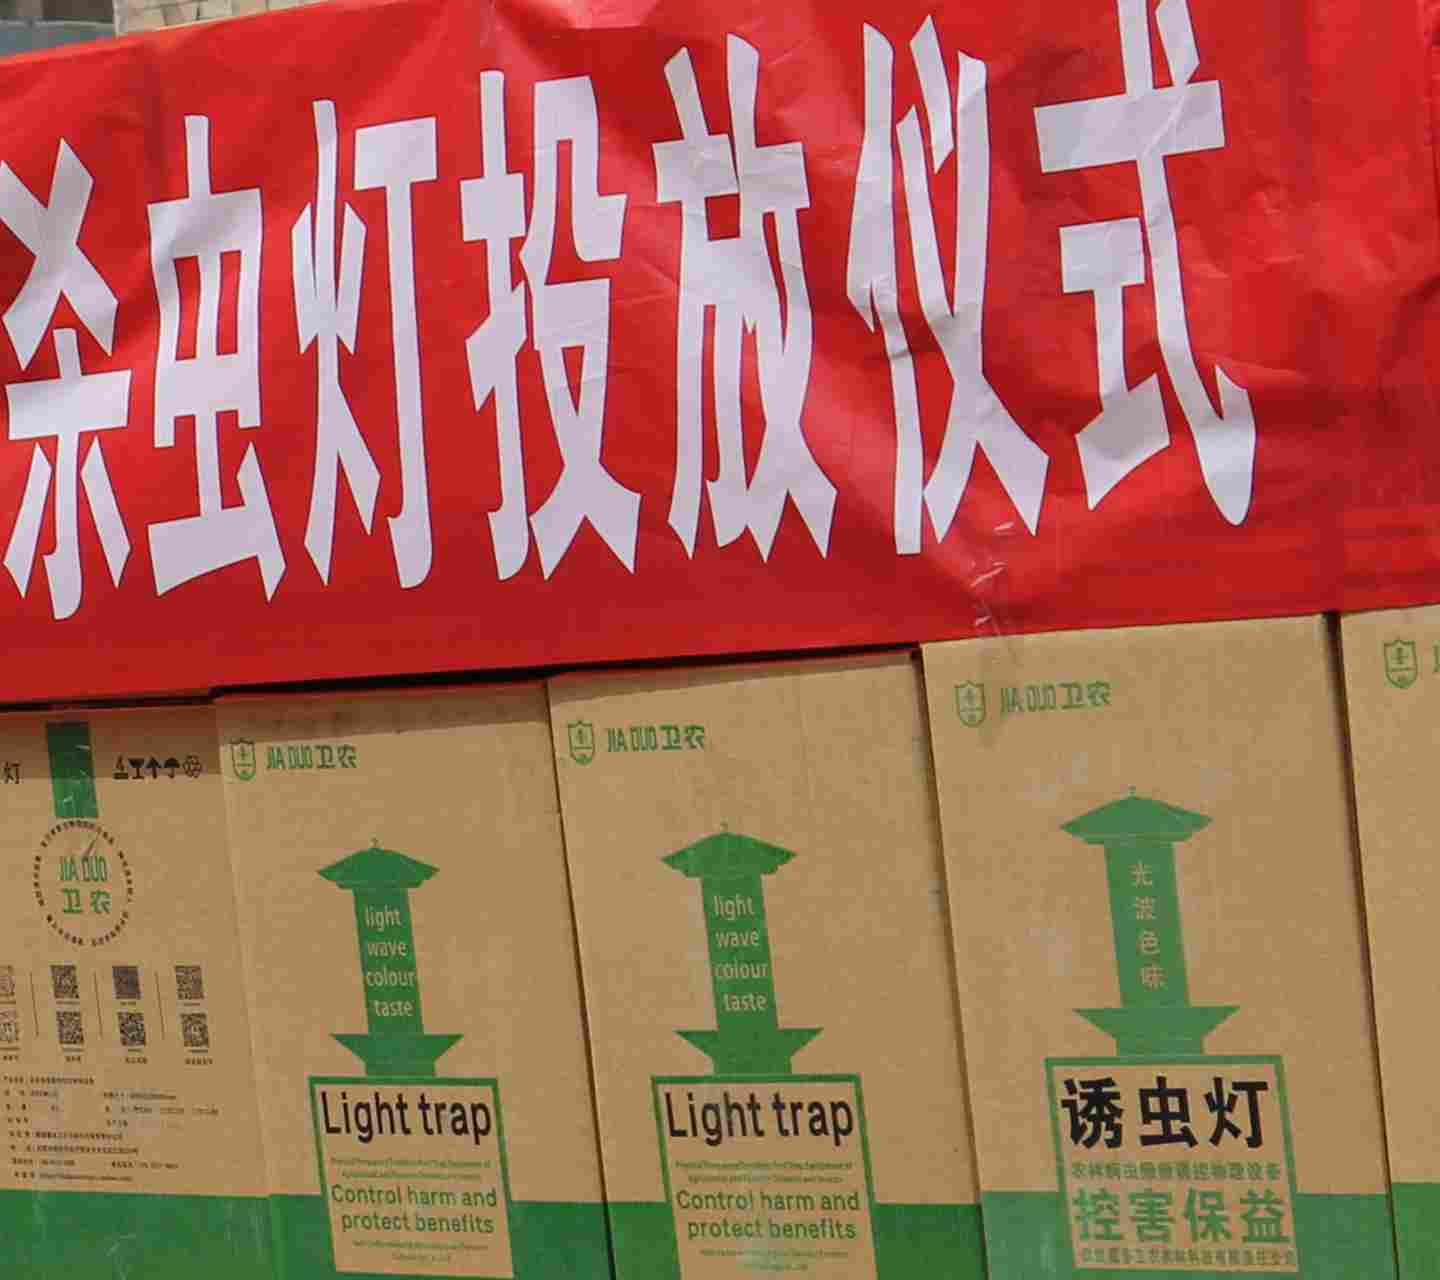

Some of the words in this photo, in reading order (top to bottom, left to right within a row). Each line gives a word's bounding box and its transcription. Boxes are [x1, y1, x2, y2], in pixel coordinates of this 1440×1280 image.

[1060, 680, 1112, 710] 卫农
[661, 725, 705, 751] 卫农
[316, 743, 358, 770] 卫农
[61, 888, 111, 915] 卫农
[714, 893, 753, 919] light
[365, 906, 401, 929] light
[367, 941, 407, 957] wave
[717, 929, 760, 949] wave
[367, 967, 416, 987] colour
[716, 958, 769, 980] colour
[374, 999, 413, 1017] taste
[724, 992, 767, 1013] taste
[321, 1091, 411, 1144] Light
[417, 1093, 492, 1146] trap
[665, 1092, 765, 1147] Light
[773, 1091, 854, 1146] trap
[1062, 1077, 1269, 1151] 诱虫灯
[331, 1184, 402, 1204] Control
[407, 1186, 456, 1206] harm
[462, 1187, 498, 1207] and
[676, 1190, 753, 1210] Control
[760, 1190, 814, 1211] harm
[820, 1191, 860, 1211] and
[342, 1211, 411, 1232] protect
[416, 1213, 495, 1234] benefits
[1071, 1186, 1291, 1244] 控害保益
[687, 1218, 764, 1240] protect
[769, 1218, 857, 1240] benefits
